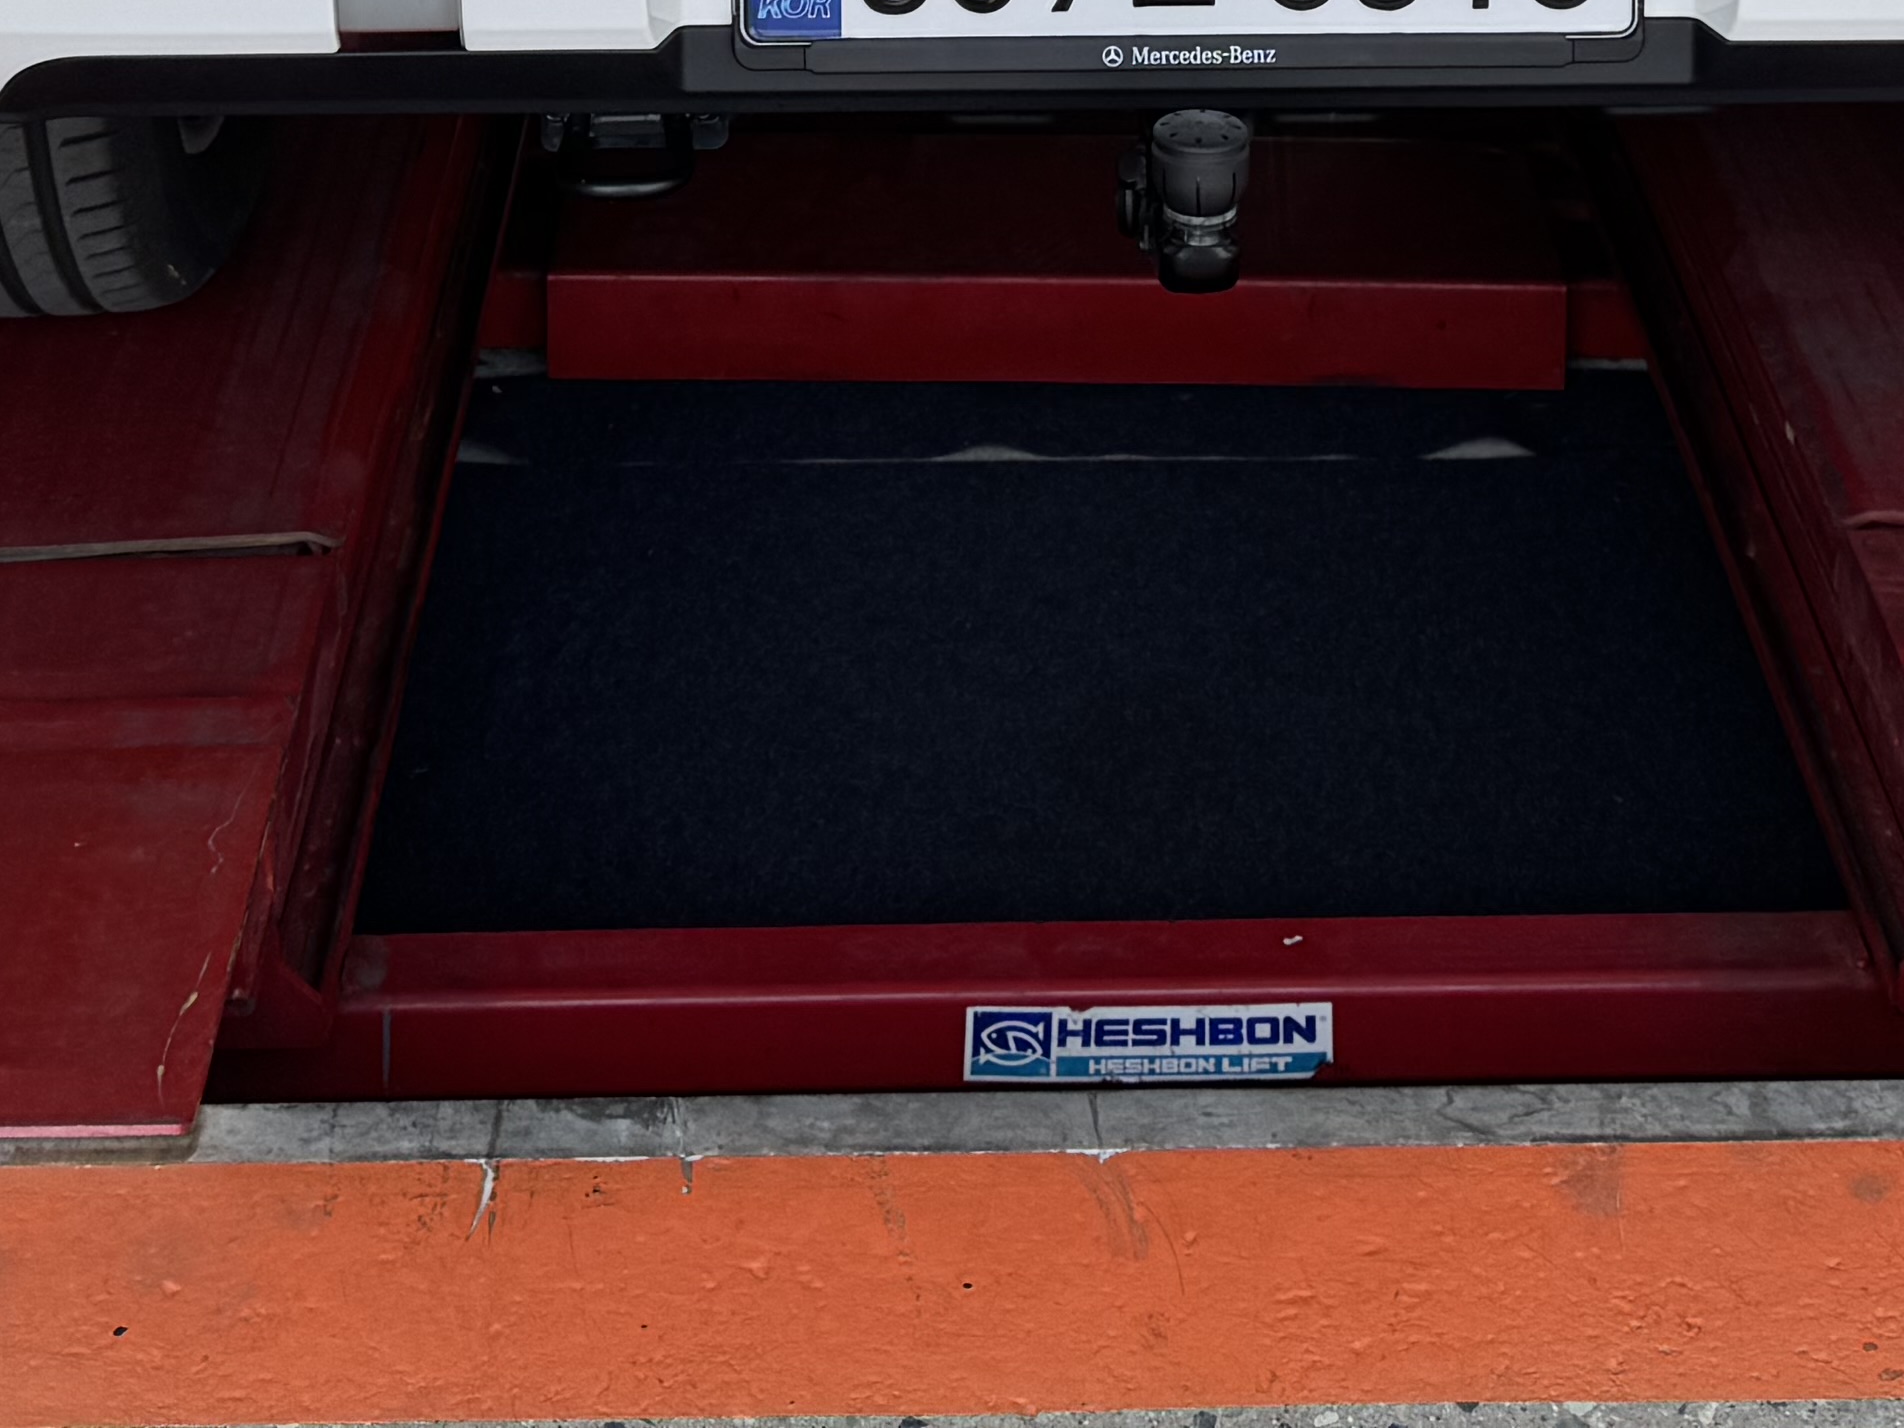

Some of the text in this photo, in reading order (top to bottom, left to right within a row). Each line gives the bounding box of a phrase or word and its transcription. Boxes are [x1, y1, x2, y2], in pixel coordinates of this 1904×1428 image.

[1130, 43, 1277, 67] Mercedes-Benz
[1057, 1014, 1317, 1048] HESHBON
[1088, 1055, 1293, 1075] HESHBON LIFT
